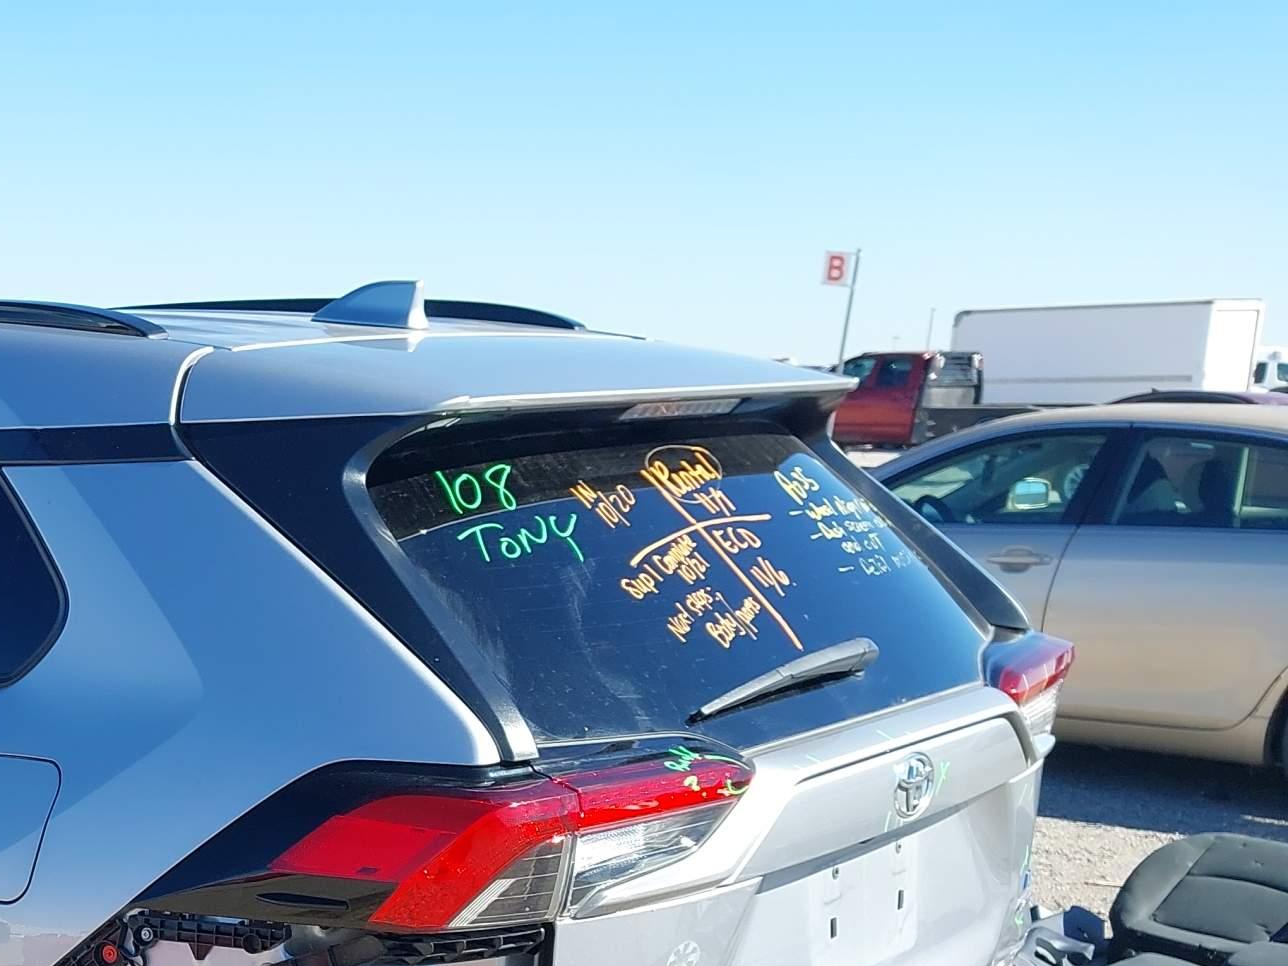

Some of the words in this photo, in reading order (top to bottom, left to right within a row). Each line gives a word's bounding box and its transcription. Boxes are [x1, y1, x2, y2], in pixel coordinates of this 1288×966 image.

[827, 256, 846, 281] B
[435, 465, 517, 514] 108
[595, 484, 636, 528] 10/20
[713, 527, 762, 554] ECD
